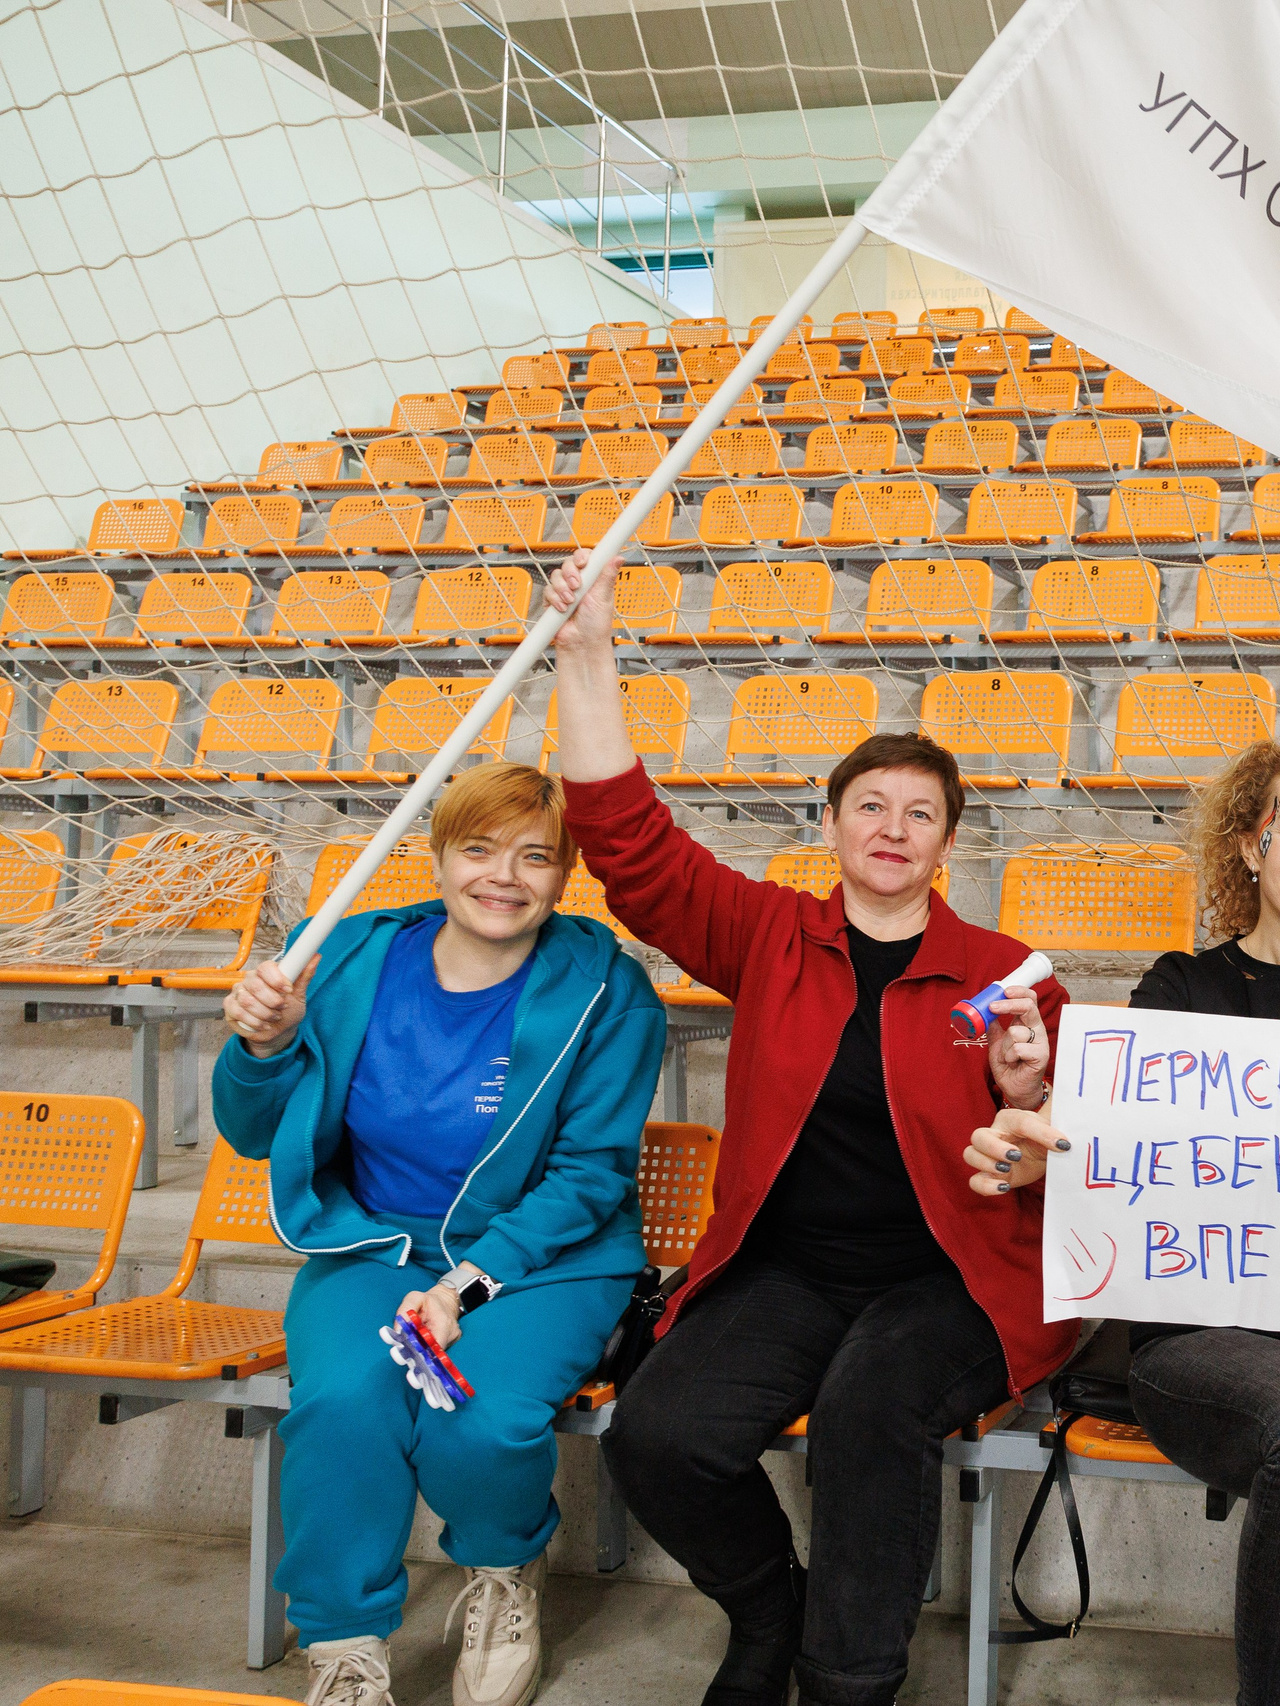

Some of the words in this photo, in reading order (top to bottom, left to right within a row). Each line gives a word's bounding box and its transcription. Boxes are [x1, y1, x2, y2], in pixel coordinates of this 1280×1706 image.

[1139, 71, 1266, 200] УГПХ
[1020, 484, 1026, 492] 9
[1162, 481, 1168, 489] 8
[746, 490, 758, 498] 11
[880, 486, 892, 494] 10
[618, 492, 630, 500] 12
[928, 565, 935, 574] 9
[1091, 566, 1099, 575] 8
[328, 576, 342, 584] 13
[468, 573, 482, 581] 12
[618, 572, 631, 580] 11
[54, 577, 67, 585] 15
[191, 578, 205, 586] 14
[800, 682, 809, 693] 9
[992, 679, 1001, 690] 8
[107, 685, 122, 696] 13
[268, 684, 283, 694] 12
[438, 684, 453, 694] 11
[23, 1102, 49, 1122] 10
